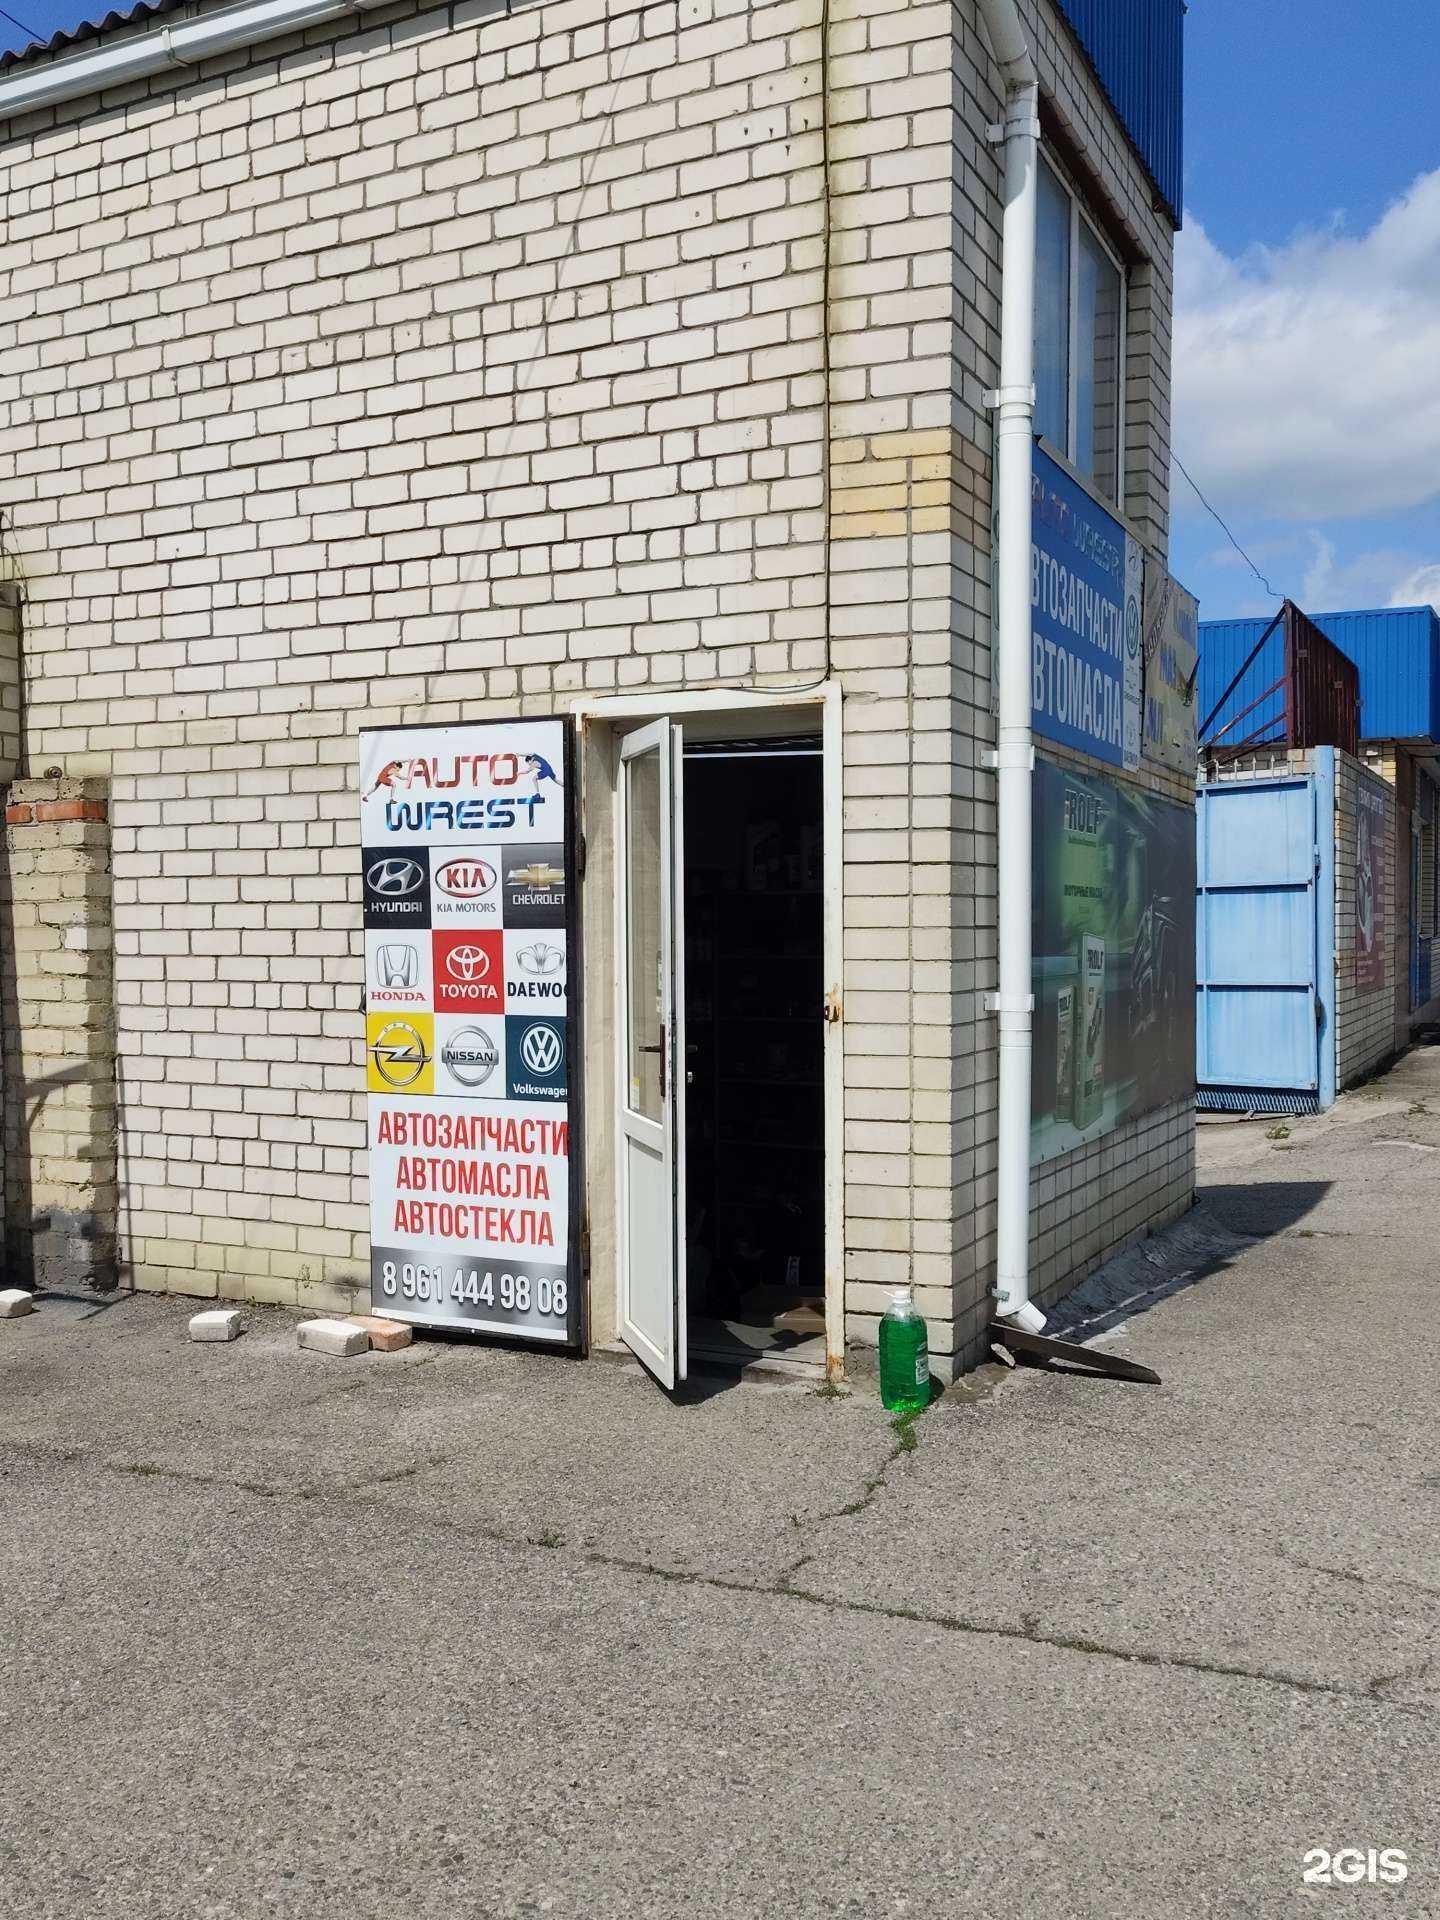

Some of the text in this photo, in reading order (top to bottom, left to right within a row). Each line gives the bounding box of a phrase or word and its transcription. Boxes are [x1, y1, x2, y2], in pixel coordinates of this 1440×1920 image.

[1031, 542, 1122, 661] ВТОЗАПЧАСТИ
[1033, 631, 1122, 748] ВТОМАСЛА
[407, 753, 518, 790] AUTO
[386, 797, 545, 832] WREST
[446, 868, 487, 888] KIA
[371, 901, 423, 913] HYUNDAI
[436, 902, 497, 913] KIA MOTORS
[512, 893, 566, 905] CHEVROLET
[370, 991, 426, 1001] HONDA
[440, 984, 499, 999] TOYOTA
[446, 1050, 494, 1062] NISSAN
[378, 1111, 568, 1157] АВТОЗАПЧАСТИ
[396, 1156, 550, 1200] АВТОМАСЛА
[394, 1199, 554, 1247] АВТОСТЕКЛА
[382, 1261, 568, 1315] 8 961 444 98 08
